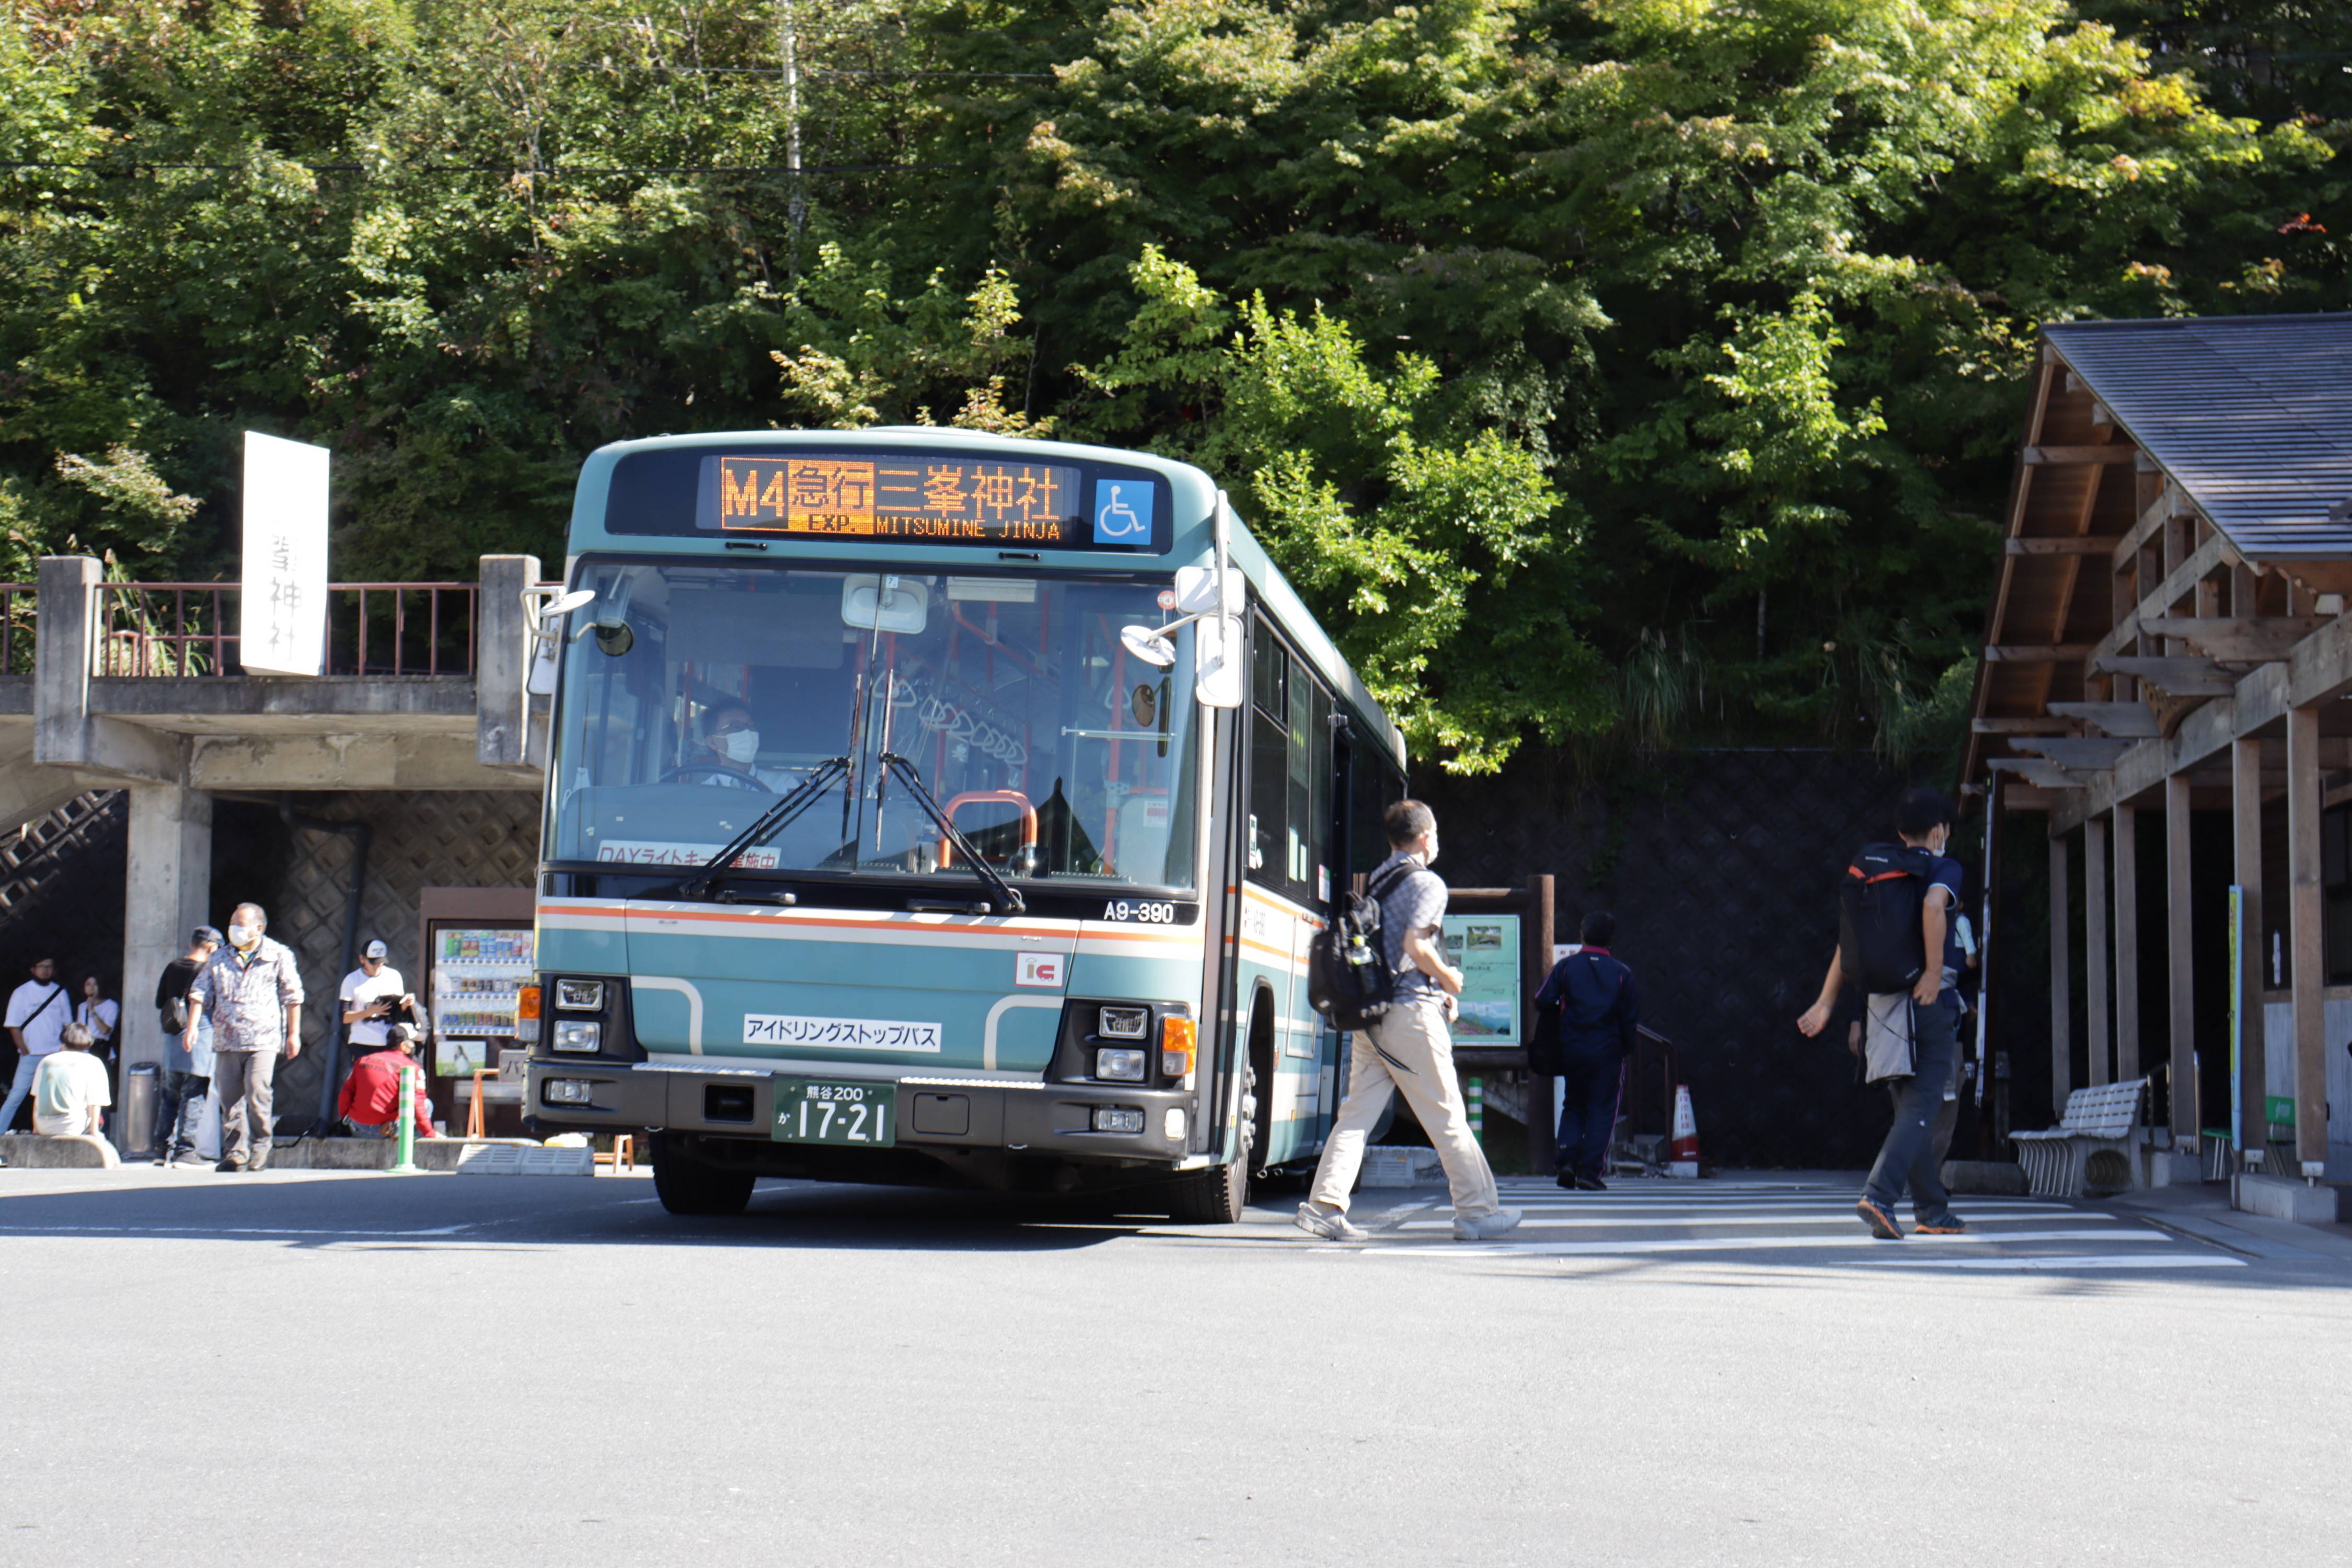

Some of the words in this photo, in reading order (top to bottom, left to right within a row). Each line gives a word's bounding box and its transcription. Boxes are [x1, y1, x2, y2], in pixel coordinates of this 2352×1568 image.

[725, 469, 784, 516] M4
[792, 465, 870, 509] 急行
[877, 465, 1059, 520] 三峯神社
[809, 514, 856, 532] EXP.
[877, 516, 986, 537] MITSUMINE
[999, 520, 1059, 540] JINJA
[1103, 901, 1174, 924] A9-390
[747, 1020, 936, 1046] アイドリングストップバス
[778, 1112, 791, 1125] か
[799, 1100, 885, 1142] 17-21
